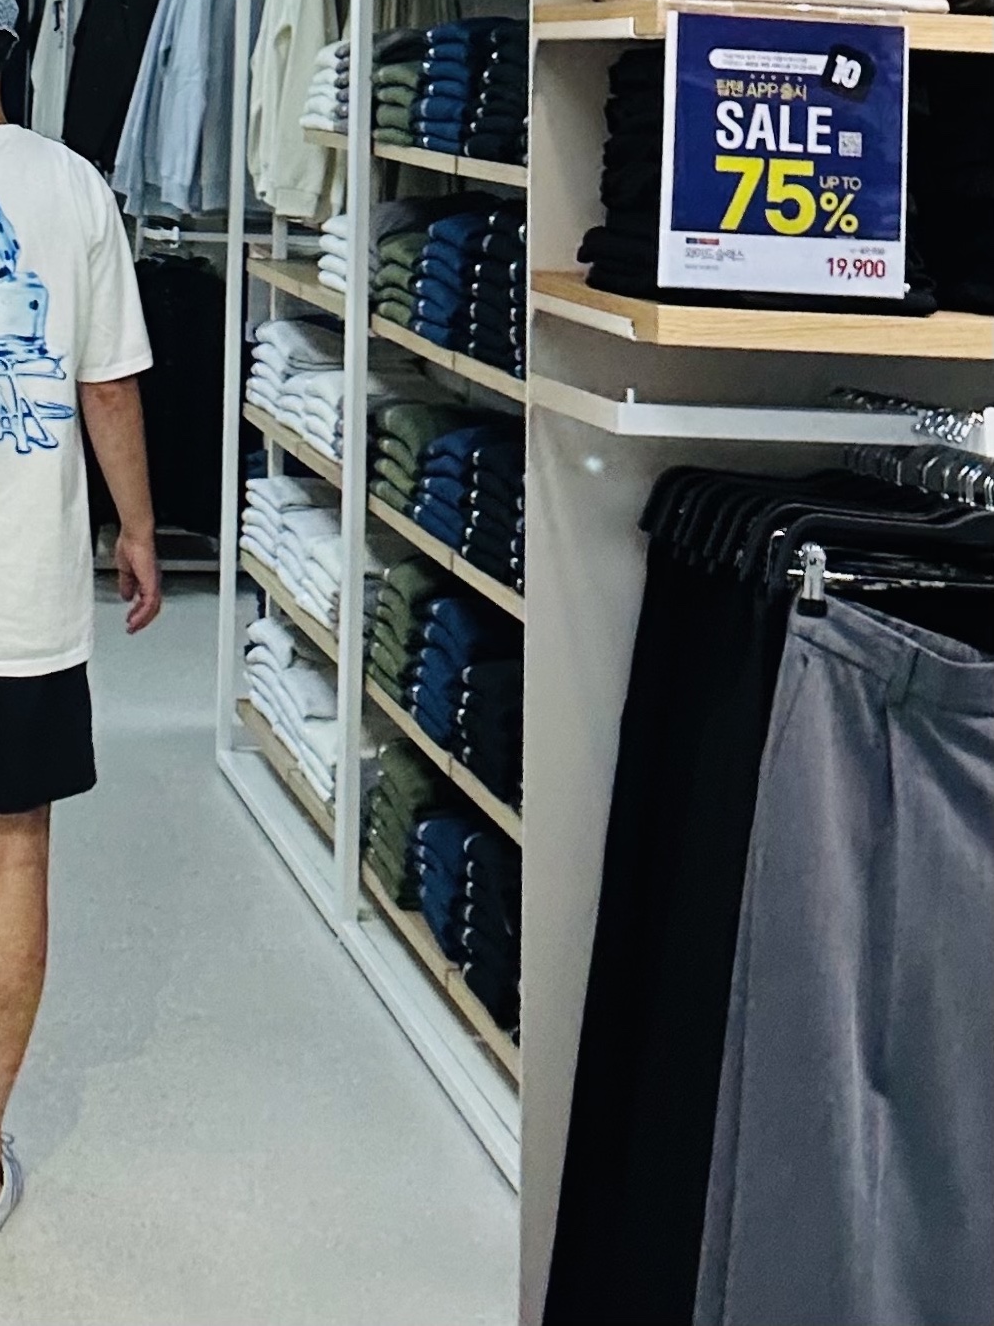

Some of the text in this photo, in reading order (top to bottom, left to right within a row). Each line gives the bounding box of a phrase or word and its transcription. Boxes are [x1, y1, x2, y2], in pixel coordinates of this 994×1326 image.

[746, 81, 779, 98] APP
[715, 100, 833, 154] SALE
[819, 175, 862, 191] UP TO
[825, 257, 886, 279] 19,900
